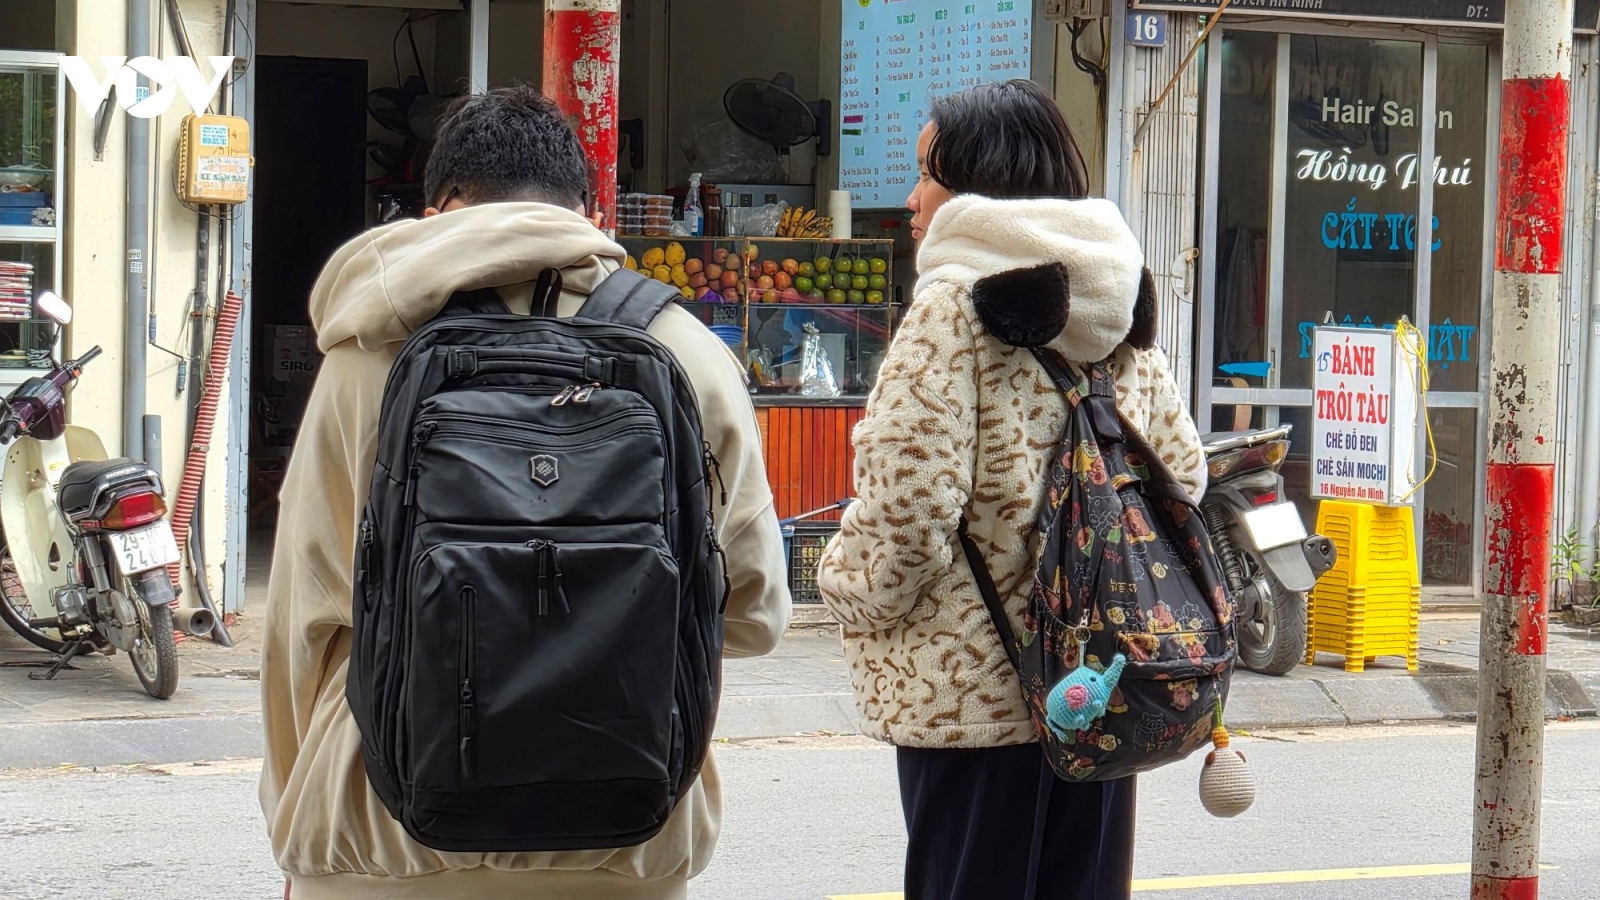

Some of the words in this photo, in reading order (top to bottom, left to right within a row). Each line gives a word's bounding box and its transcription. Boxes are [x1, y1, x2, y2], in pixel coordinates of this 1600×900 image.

[1134, 15, 1157, 40] 16
[1321, 97, 1375, 124] Hair
[1382, 100, 1453, 129] San
[1296, 147, 1388, 190] Hồng
[1320, 197, 1378, 250] CẮT
[1332, 335, 1375, 376] BÁNH
[1317, 381, 1353, 421] TRÔI
[1356, 383, 1389, 424] TÀU
[1326, 429, 1343, 449] CHÈ
[1359, 434, 1377, 452] ĐEN
[1316, 456, 1334, 476] CHÈ
[1357, 462, 1386, 481] MOCHI
[1320, 483, 1329, 495] 16
[1356, 486, 1367, 498] An
[1368, 487, 1384, 500] Ninh
